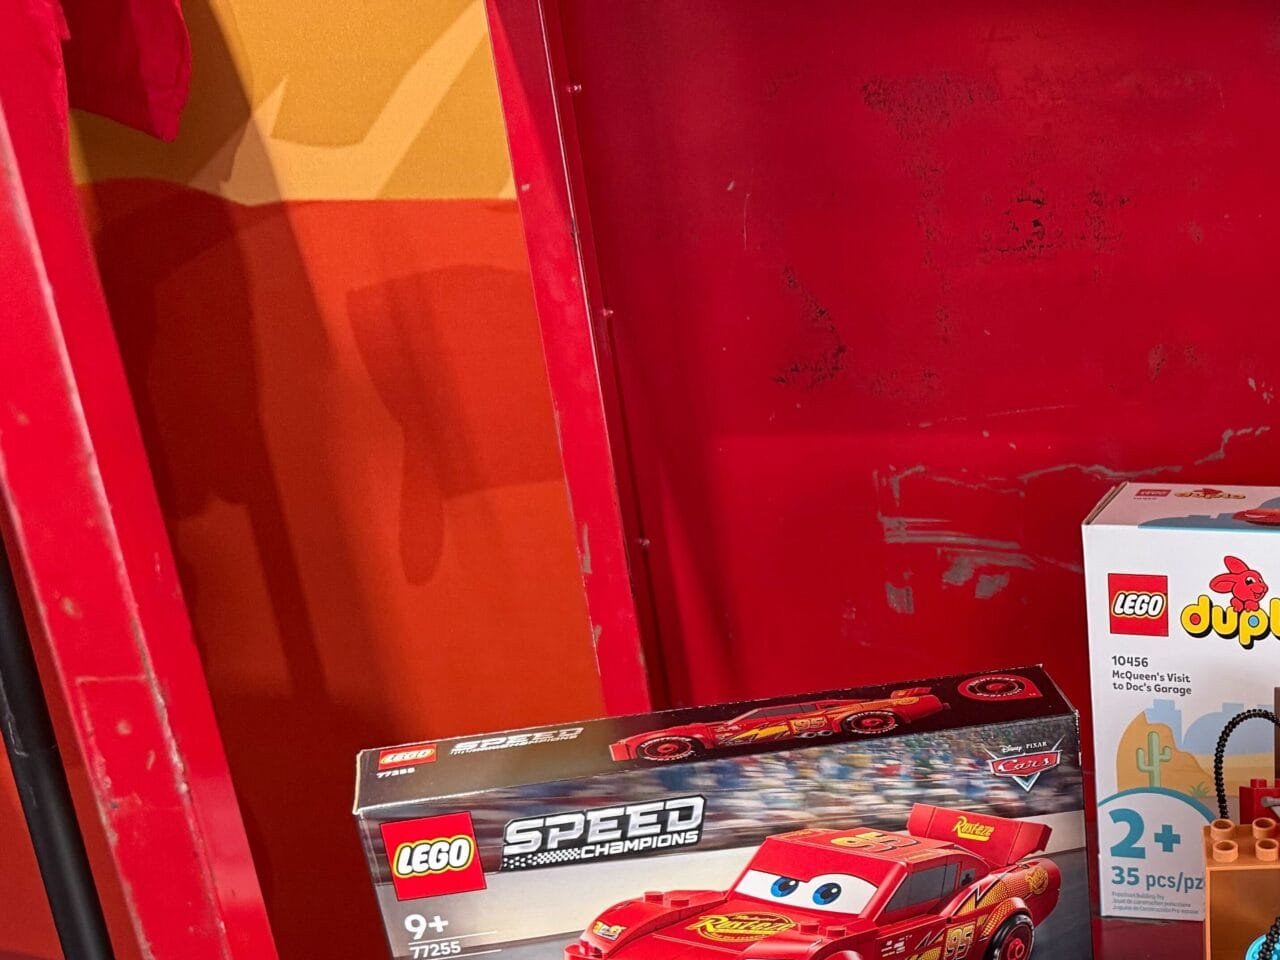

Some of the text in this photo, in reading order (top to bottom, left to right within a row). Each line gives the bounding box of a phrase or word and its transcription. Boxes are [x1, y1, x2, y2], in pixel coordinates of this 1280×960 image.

[1112, 592, 1166, 617] LEGO
[1112, 655, 1149, 668] 10456
[1112, 670, 1191, 683] McQueen's Visit
[1112, 682, 1192, 697] to Doc's Garage
[1026, 741, 1047, 750] PIXAR
[503, 796, 705, 856] SPEED
[1108, 808, 1181, 859] 2+
[396, 836, 473, 877] LEGO
[581, 830, 700, 859] CHAMPIONS
[1111, 866, 1204, 893] 35 pcs/pz
[404, 913, 449, 940] 9+
[409, 941, 462, 959] 77255
